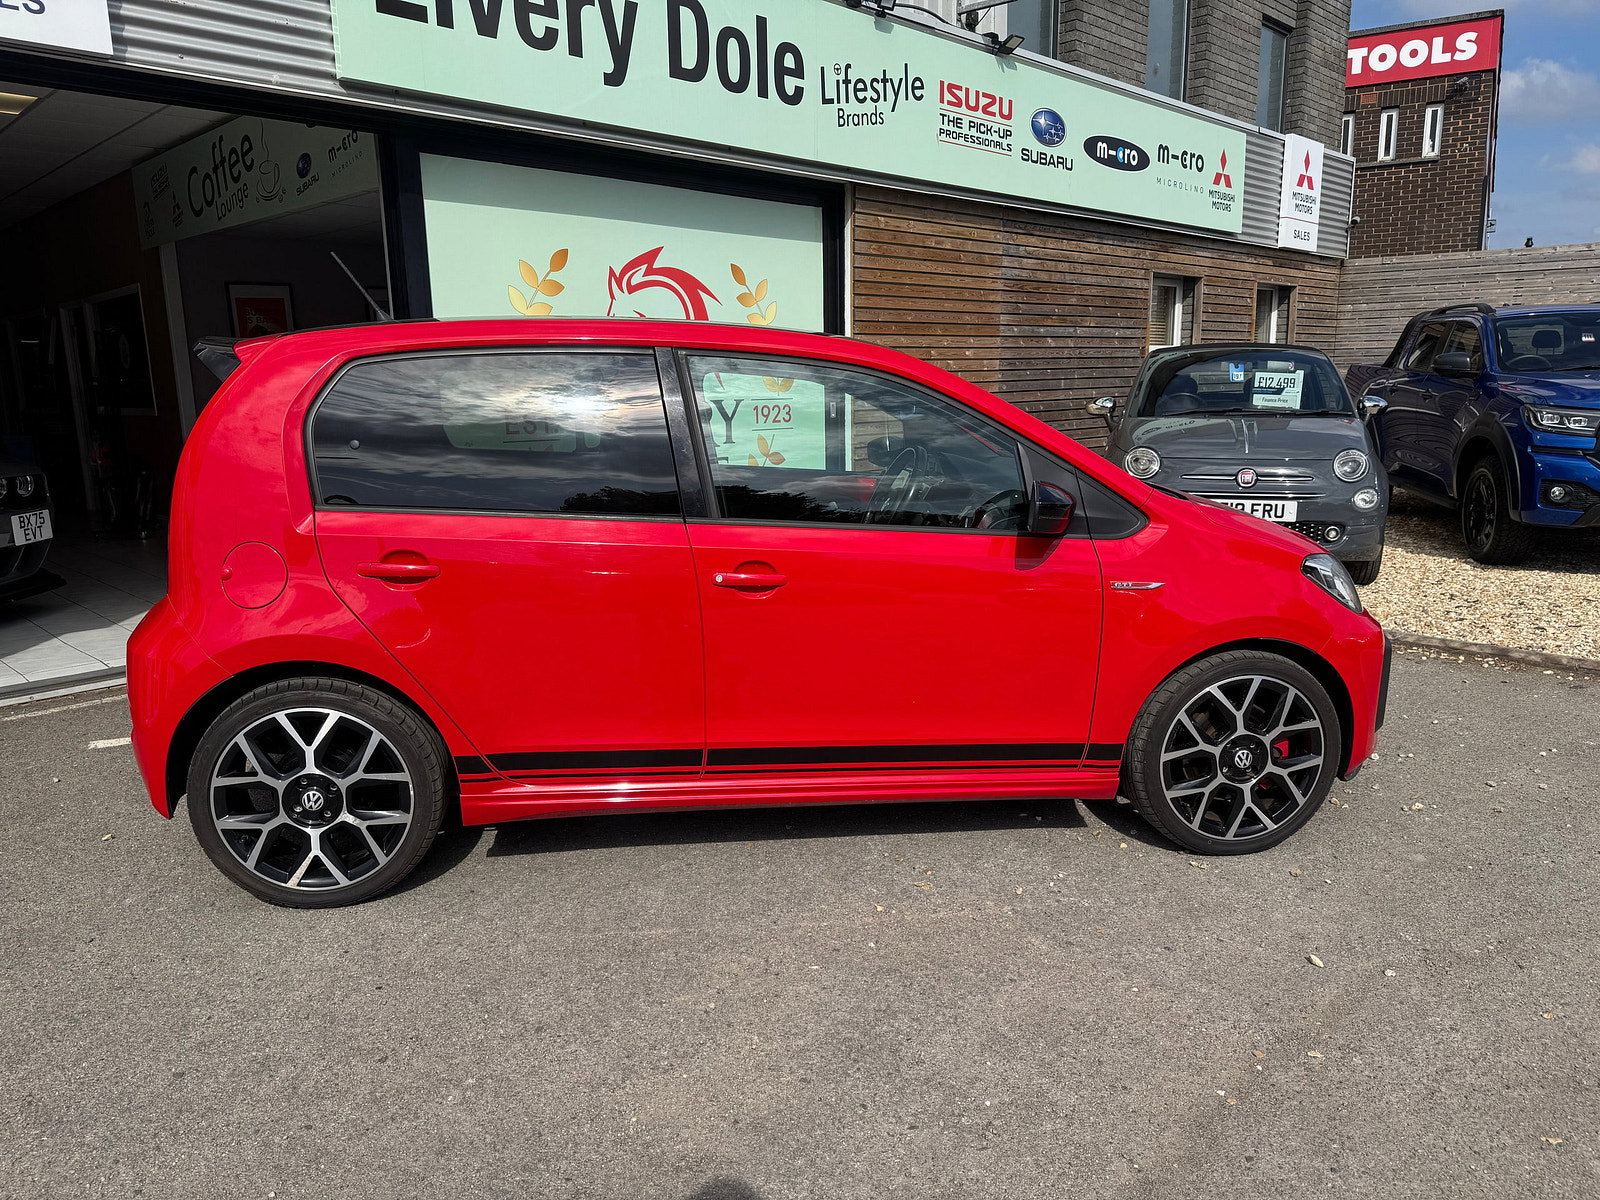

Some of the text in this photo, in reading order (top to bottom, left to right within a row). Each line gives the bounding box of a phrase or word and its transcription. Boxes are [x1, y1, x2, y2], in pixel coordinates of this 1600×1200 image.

[376, 0, 805, 106] very Dole
[1347, 31, 1479, 75] TOOLS
[820, 63, 925, 112] Lifestyle
[939, 79, 1013, 121] ISUZU
[837, 105, 884, 127] Brands
[939, 113, 1013, 141] THE PICK-UP
[939, 128, 1012, 152] PROFESSIONALS
[1020, 147, 1074, 171] SUBARU
[187, 134, 255, 218] Coffee
[296, 172, 320, 196] SUBARU
[1156, 176, 1204, 194] MICROLINO
[215, 182, 249, 222] Lounge
[1208, 189, 1236, 204] MITSUBISHI
[1211, 200, 1232, 213] MOTORS
[1292, 190, 1317, 205] MITSUBISHI
[1294, 202, 1313, 215] MOTORS
[1293, 229, 1311, 242] SALES
[753, 404, 792, 424] 1923
[18, 511, 45, 529] BX75
[1251, 503, 1285, 519] FRU
[24, 525, 43, 541] EVT
